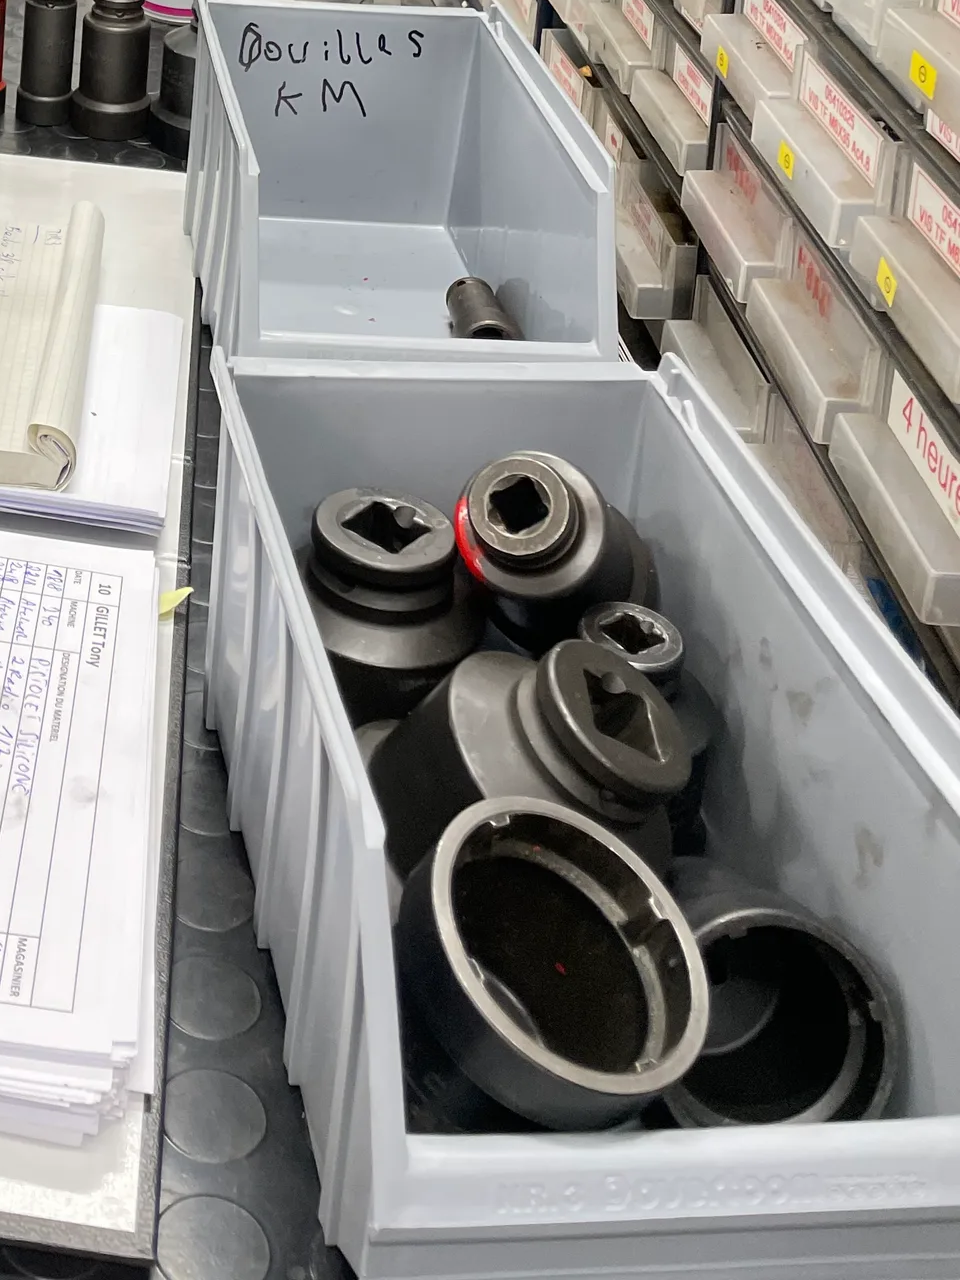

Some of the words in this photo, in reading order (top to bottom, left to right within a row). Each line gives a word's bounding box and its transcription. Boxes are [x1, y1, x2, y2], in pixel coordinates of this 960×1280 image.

[808, 87, 819, 112] VIS
[820, 100, 829, 119] TF
[919, 204, 933, 234] VIS
[934, 220, 946, 245] TF
[902, 396, 914, 434] 4
[73, 570, 83, 585] DATE
[97, 582, 113, 596] 10
[66, 600, 79, 628] MACHINE
[92, 605, 110, 640] GILLET
[85, 641, 106, 669] Tony
[57, 652, 71, 696] DESIGNATION
[54, 696, 64, 709] DU
[49, 708, 63, 743] MATERIEL
[9, 937, 28, 997] MAGASINIER
